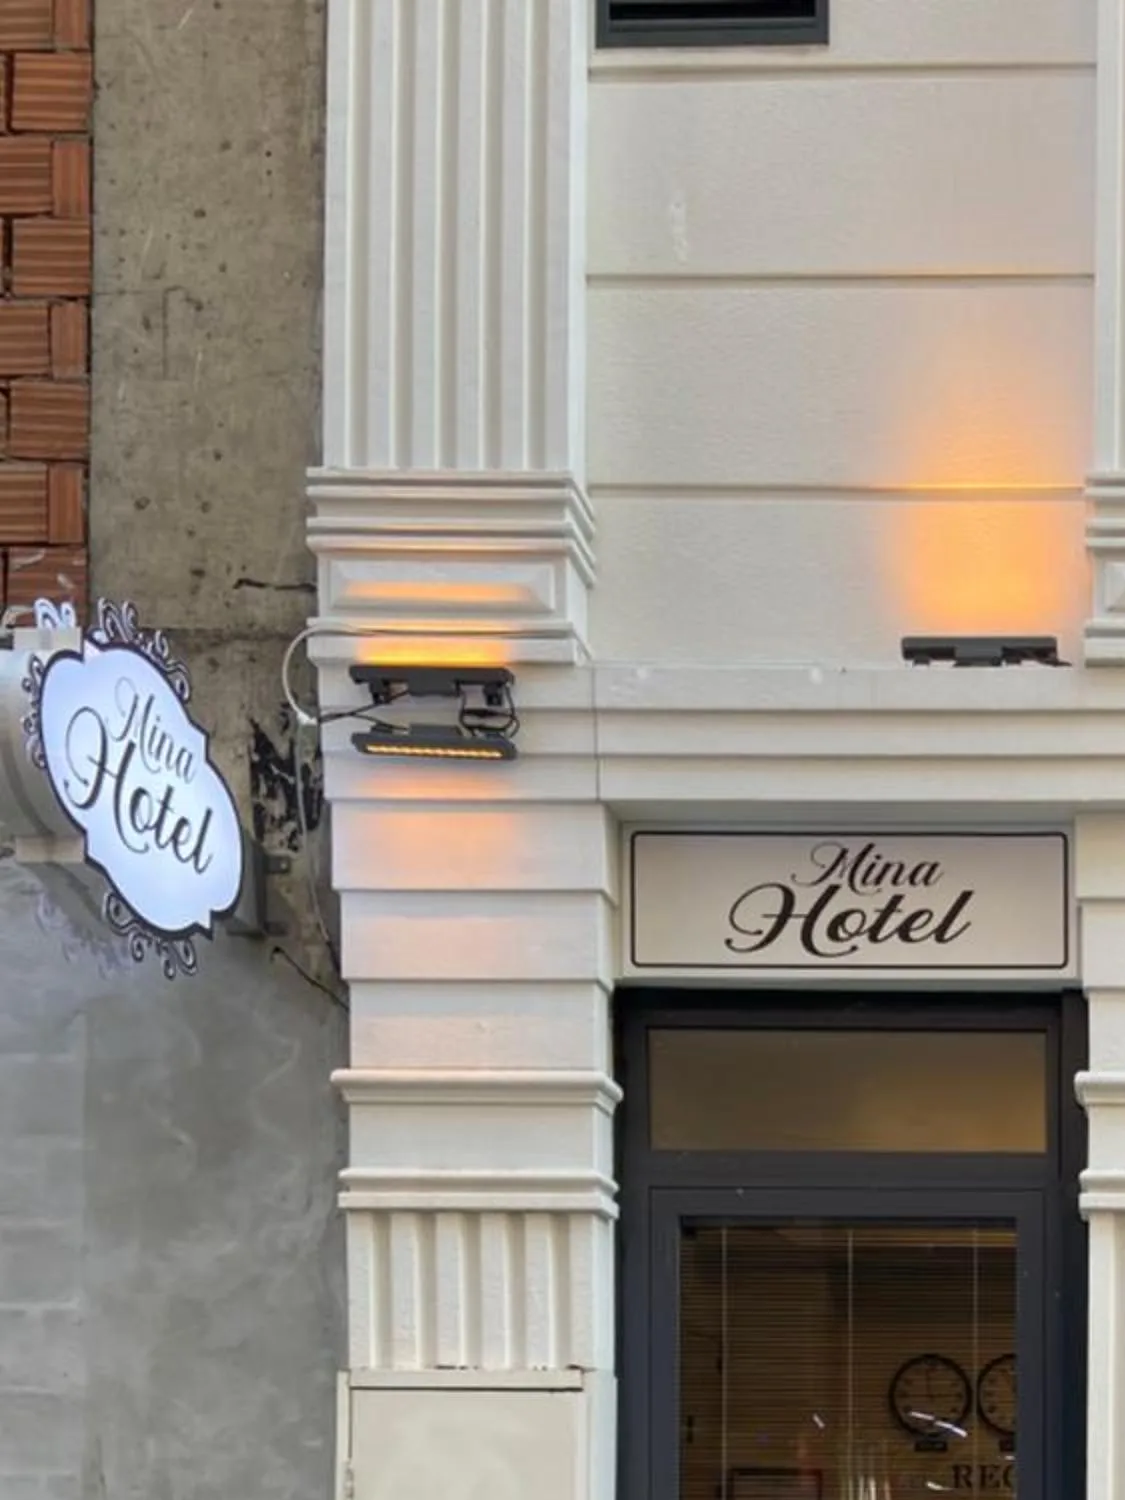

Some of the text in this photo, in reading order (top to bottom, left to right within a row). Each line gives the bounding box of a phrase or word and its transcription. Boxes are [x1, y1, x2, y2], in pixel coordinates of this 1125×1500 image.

[105, 676, 198, 783] Mina
[64, 706, 215, 874] Hotel
[791, 841, 945, 896] Mina
[724, 882, 975, 959] Hotel
